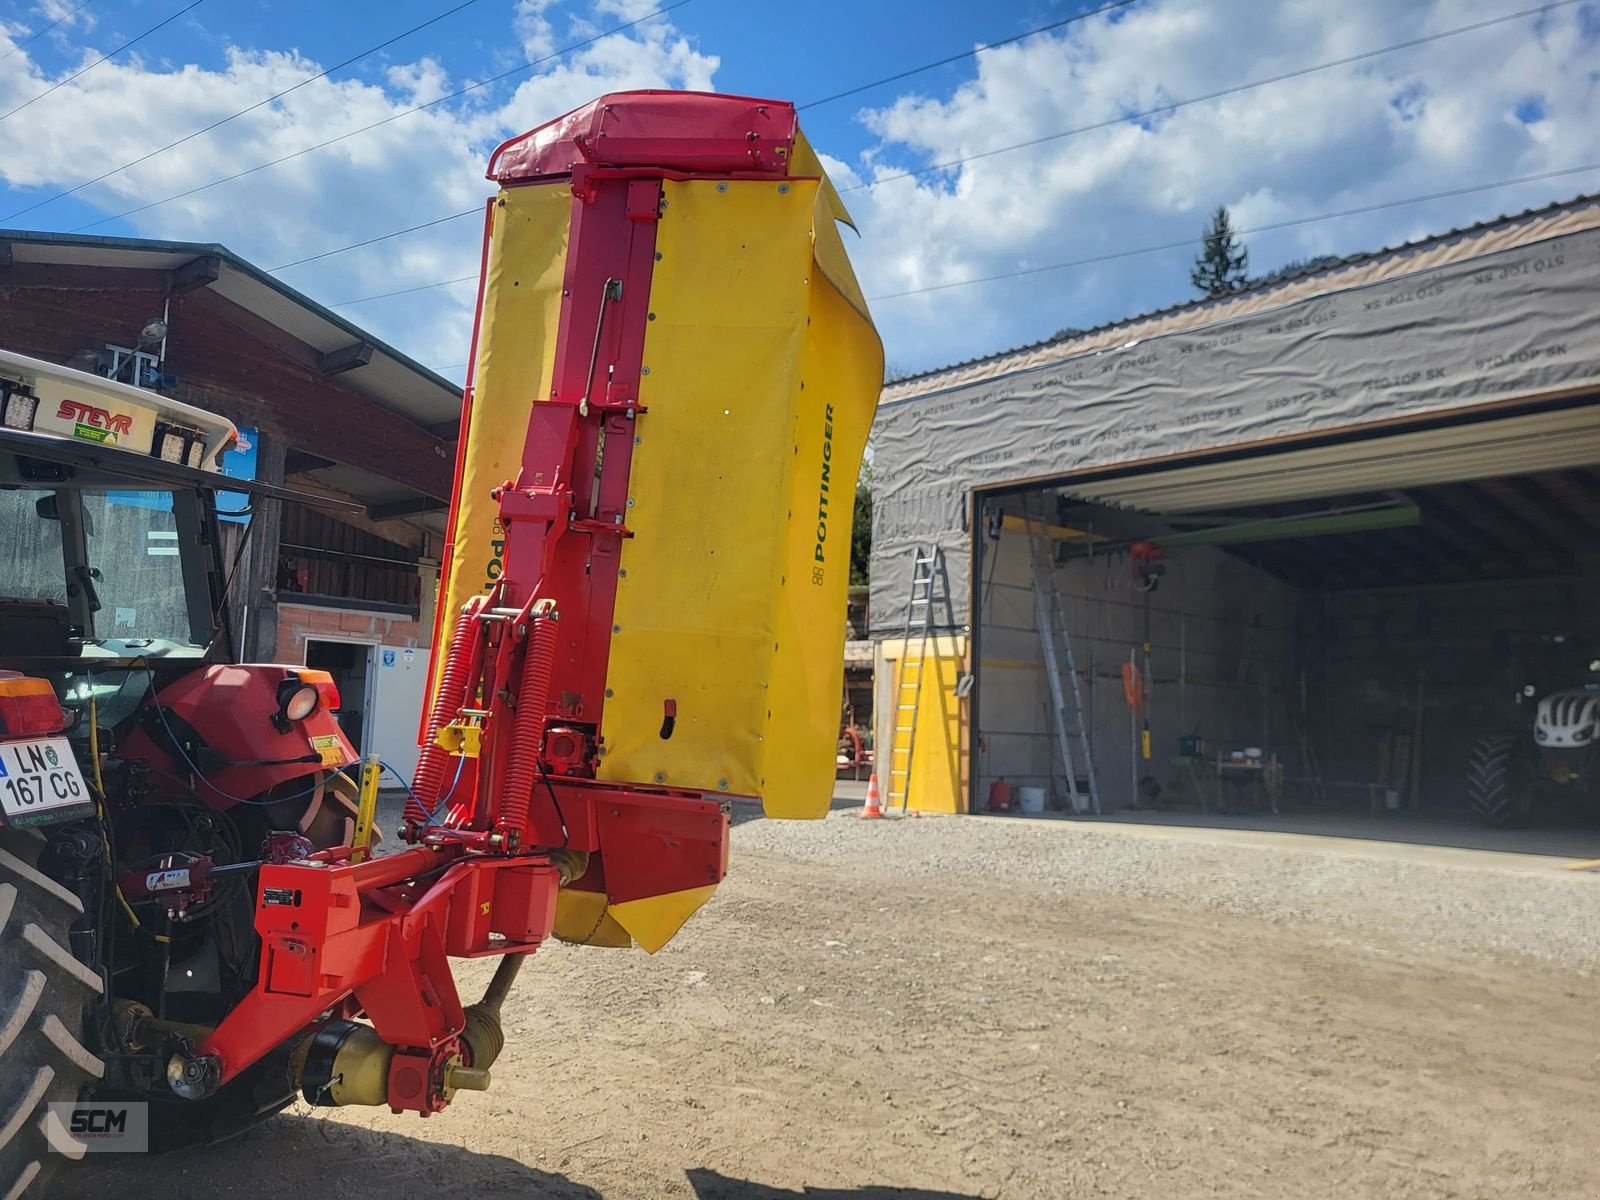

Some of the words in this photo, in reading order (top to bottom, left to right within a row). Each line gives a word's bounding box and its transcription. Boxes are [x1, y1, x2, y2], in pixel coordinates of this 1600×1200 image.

[56, 399, 132, 435] STEYR
[14, 744, 47, 773] LN
[6, 776, 43, 807] 167
[49, 771, 81, 799] CG
